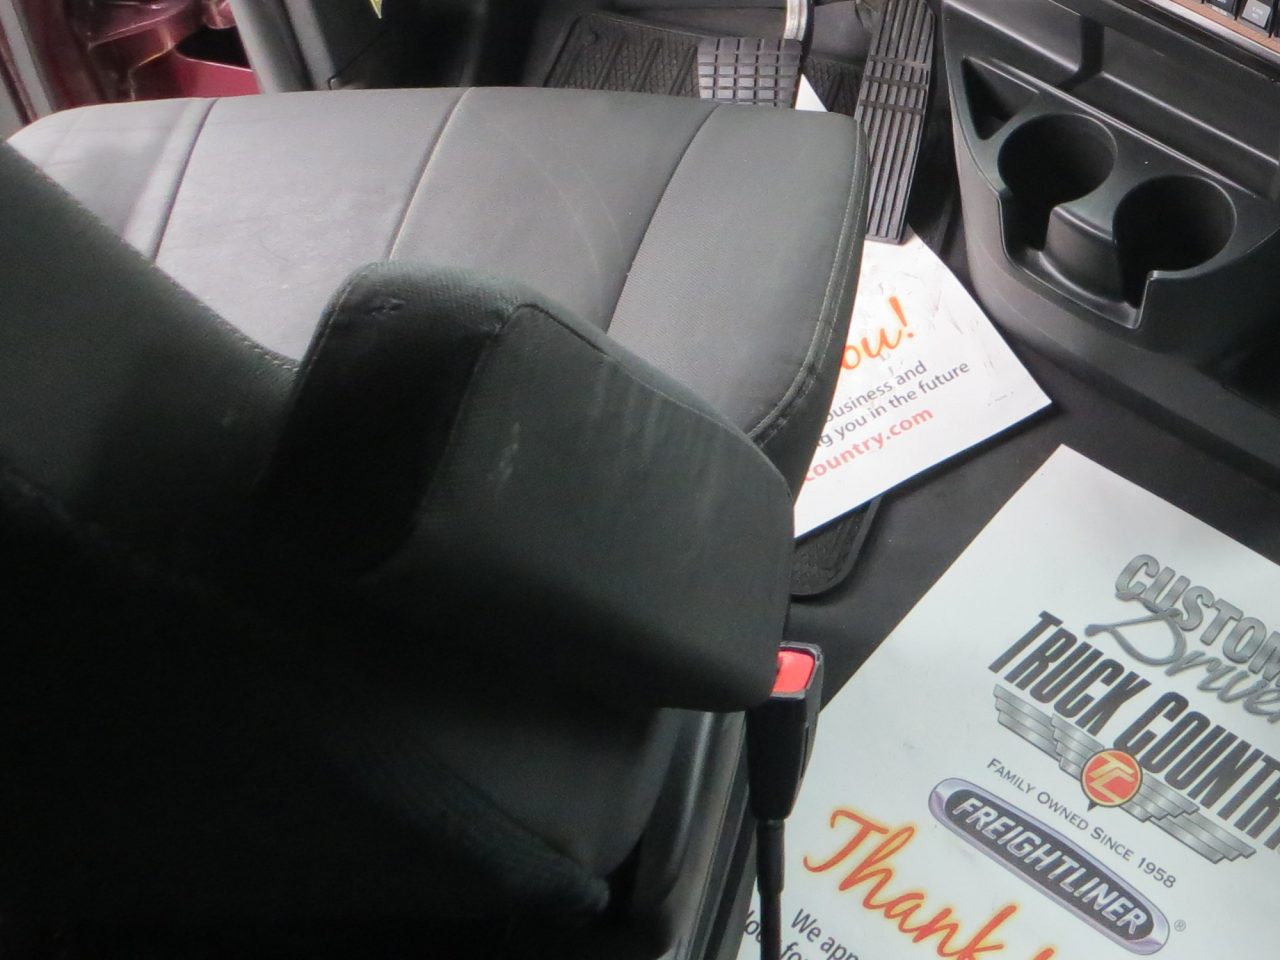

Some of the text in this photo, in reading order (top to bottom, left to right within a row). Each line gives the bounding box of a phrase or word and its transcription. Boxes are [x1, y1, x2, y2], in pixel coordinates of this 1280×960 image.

[841, 295, 915, 371] ou!
[895, 359, 928, 387] and
[834, 414, 868, 441] you
[868, 406, 888, 420] in
[888, 387, 918, 410] the
[917, 360, 970, 395] future
[987, 609, 1153, 737] TRUCK
[952, 797, 1148, 935] FREIGHTLINER
[987, 757, 1177, 889] FAMILY OWNED SINCE 1958
[790, 908, 822, 942] We
[803, 809, 1018, 960] Thank
